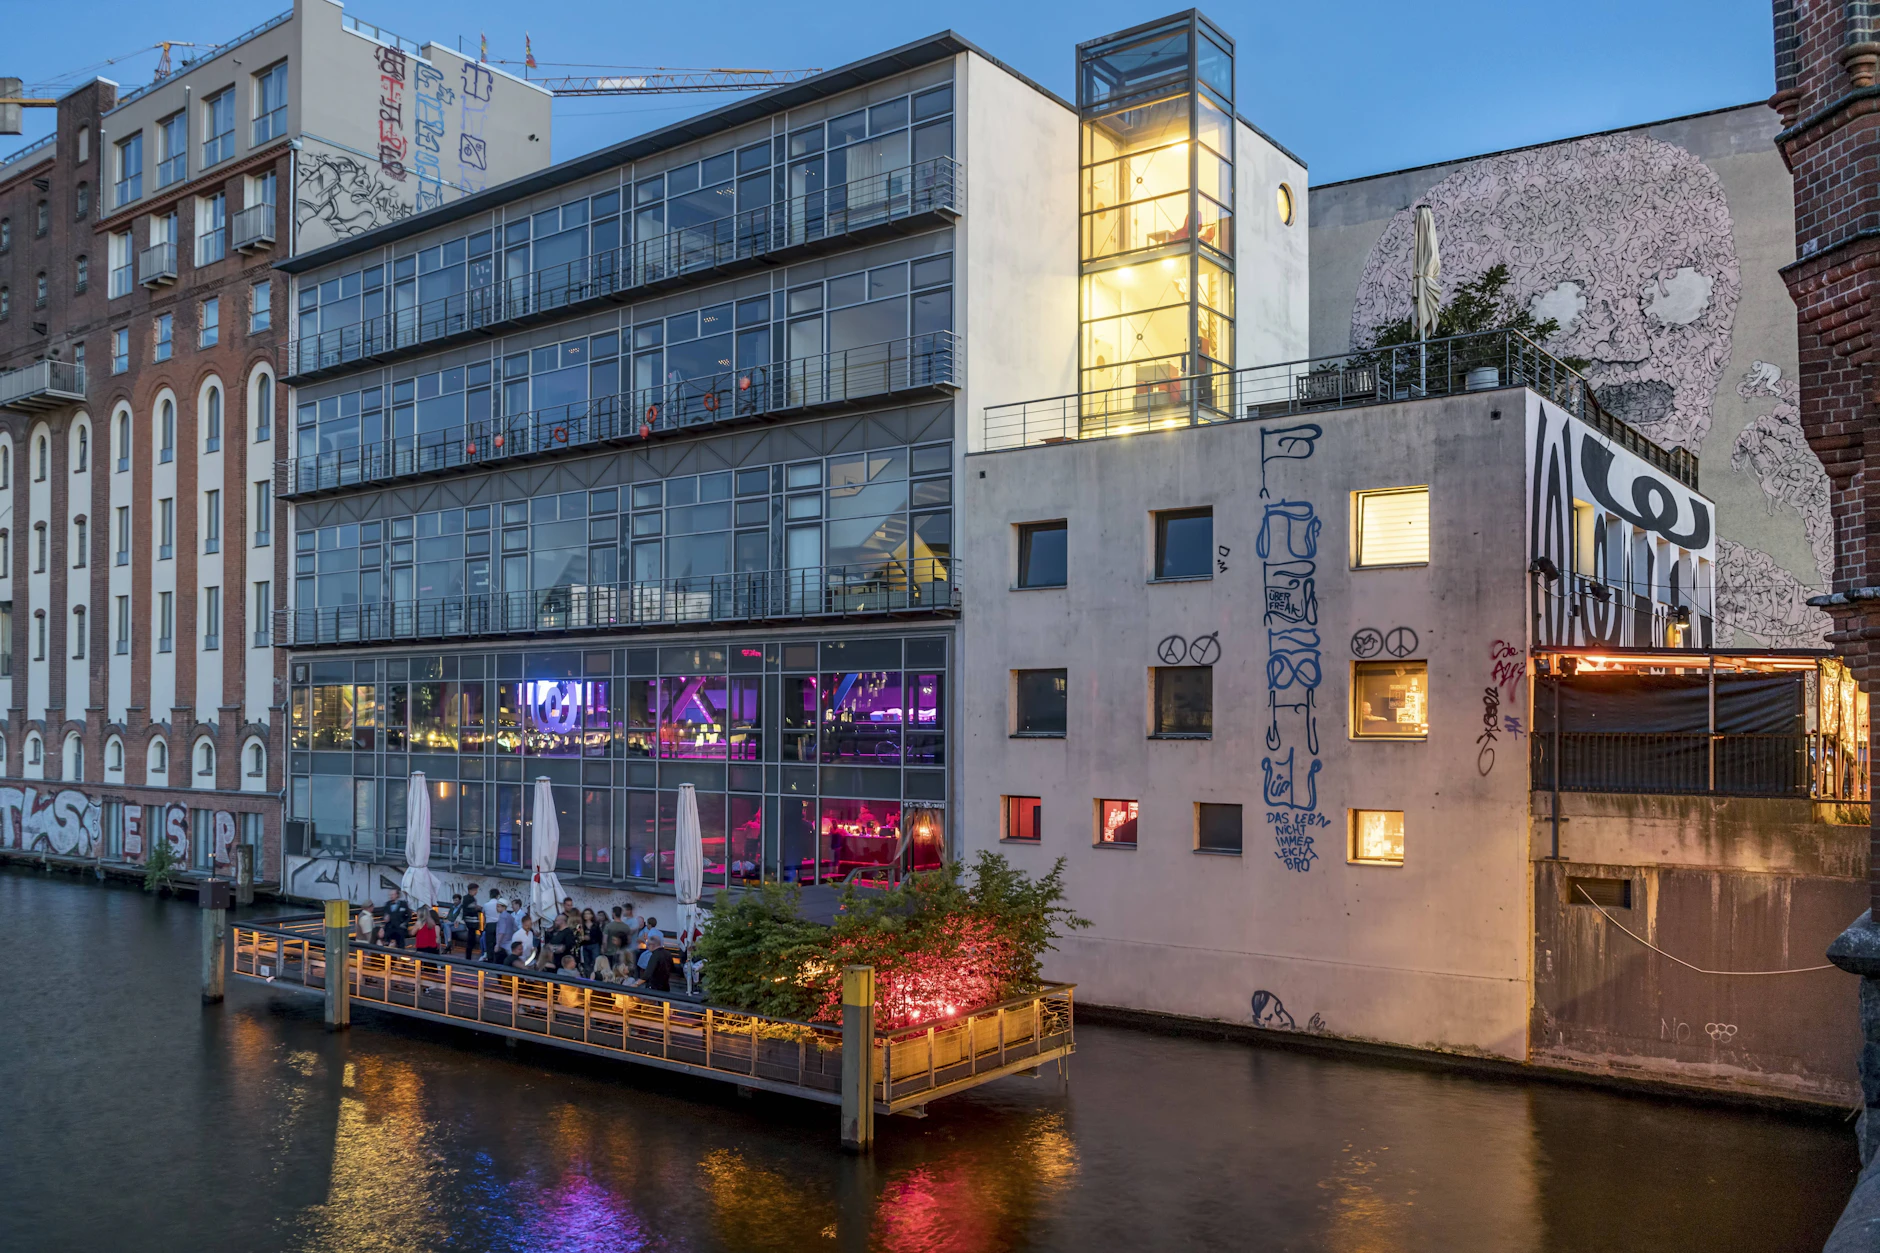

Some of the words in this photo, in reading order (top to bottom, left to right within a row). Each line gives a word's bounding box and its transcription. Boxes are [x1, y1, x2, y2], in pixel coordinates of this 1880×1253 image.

[1269, 589, 1291, 601] ÜBER
[1266, 812, 1289, 824] DAS
[1284, 857, 1309, 872] BRO
[1661, 1017, 1690, 1043] NO
